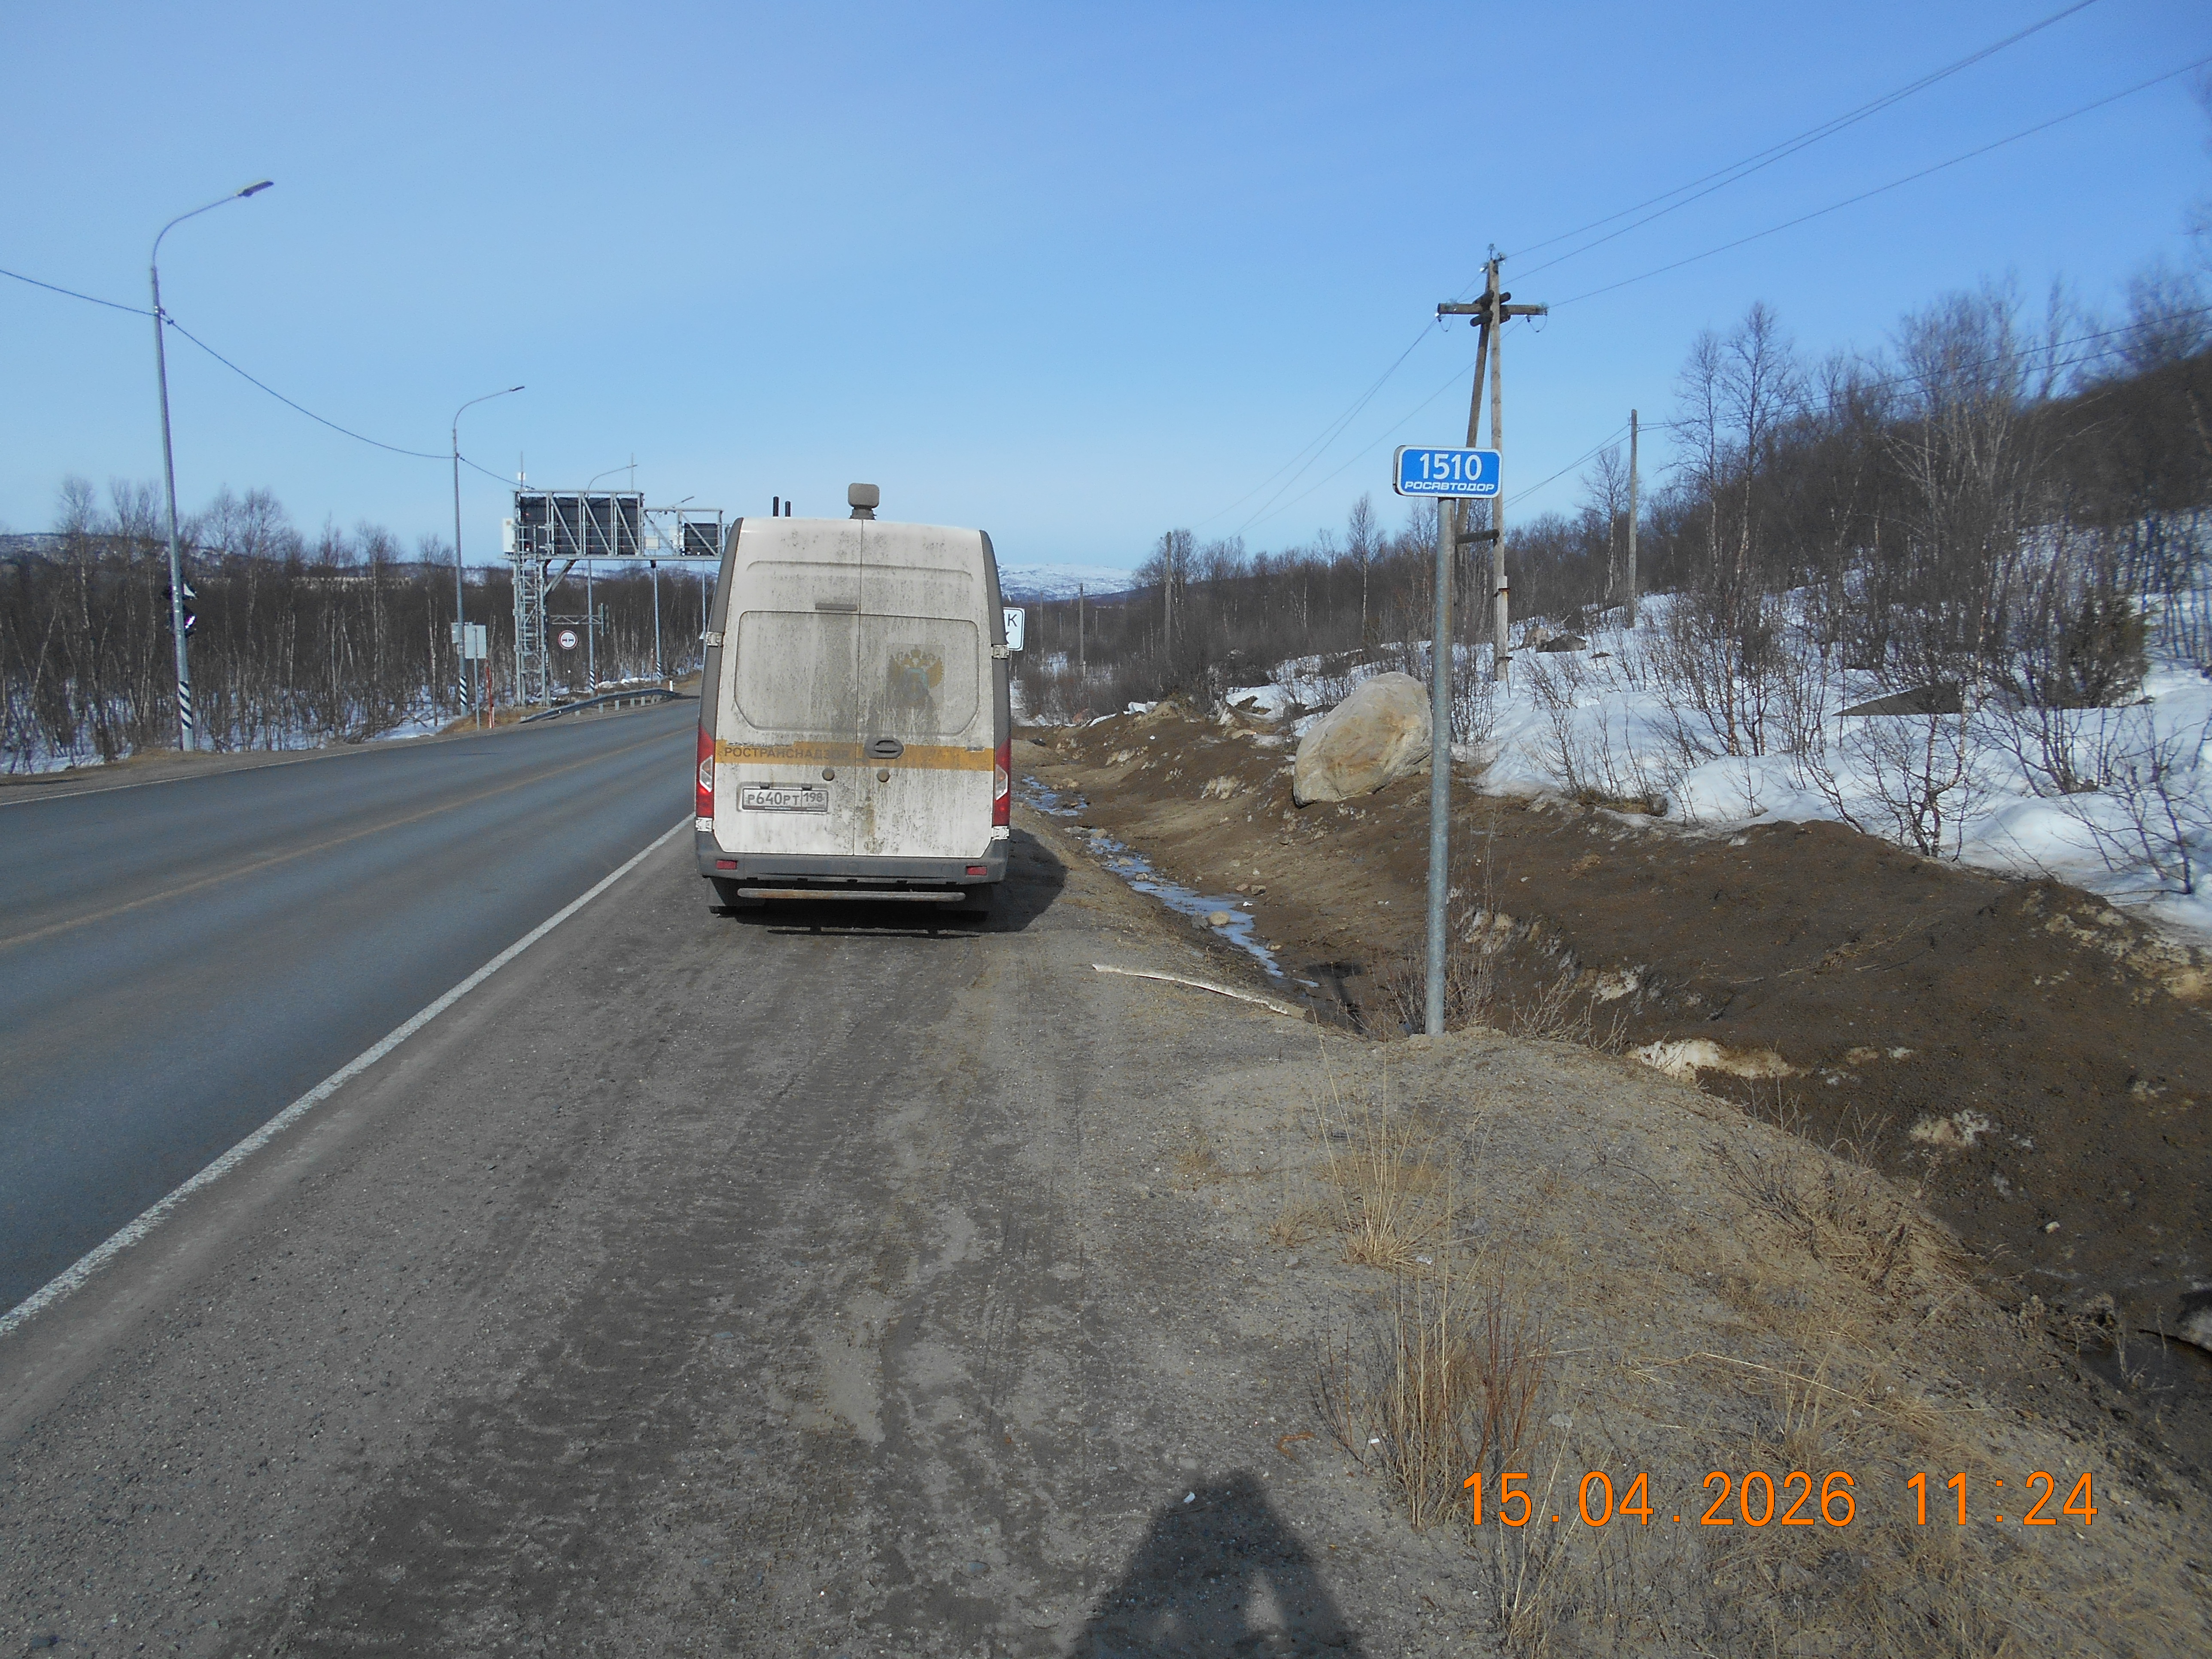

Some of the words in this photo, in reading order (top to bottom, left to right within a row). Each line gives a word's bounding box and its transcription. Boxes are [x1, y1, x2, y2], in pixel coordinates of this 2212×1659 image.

[1419, 453, 1482, 480] 1510
[1404, 481, 1494, 492] РОСАВТОДОР
[803, 792, 823, 802] 198
